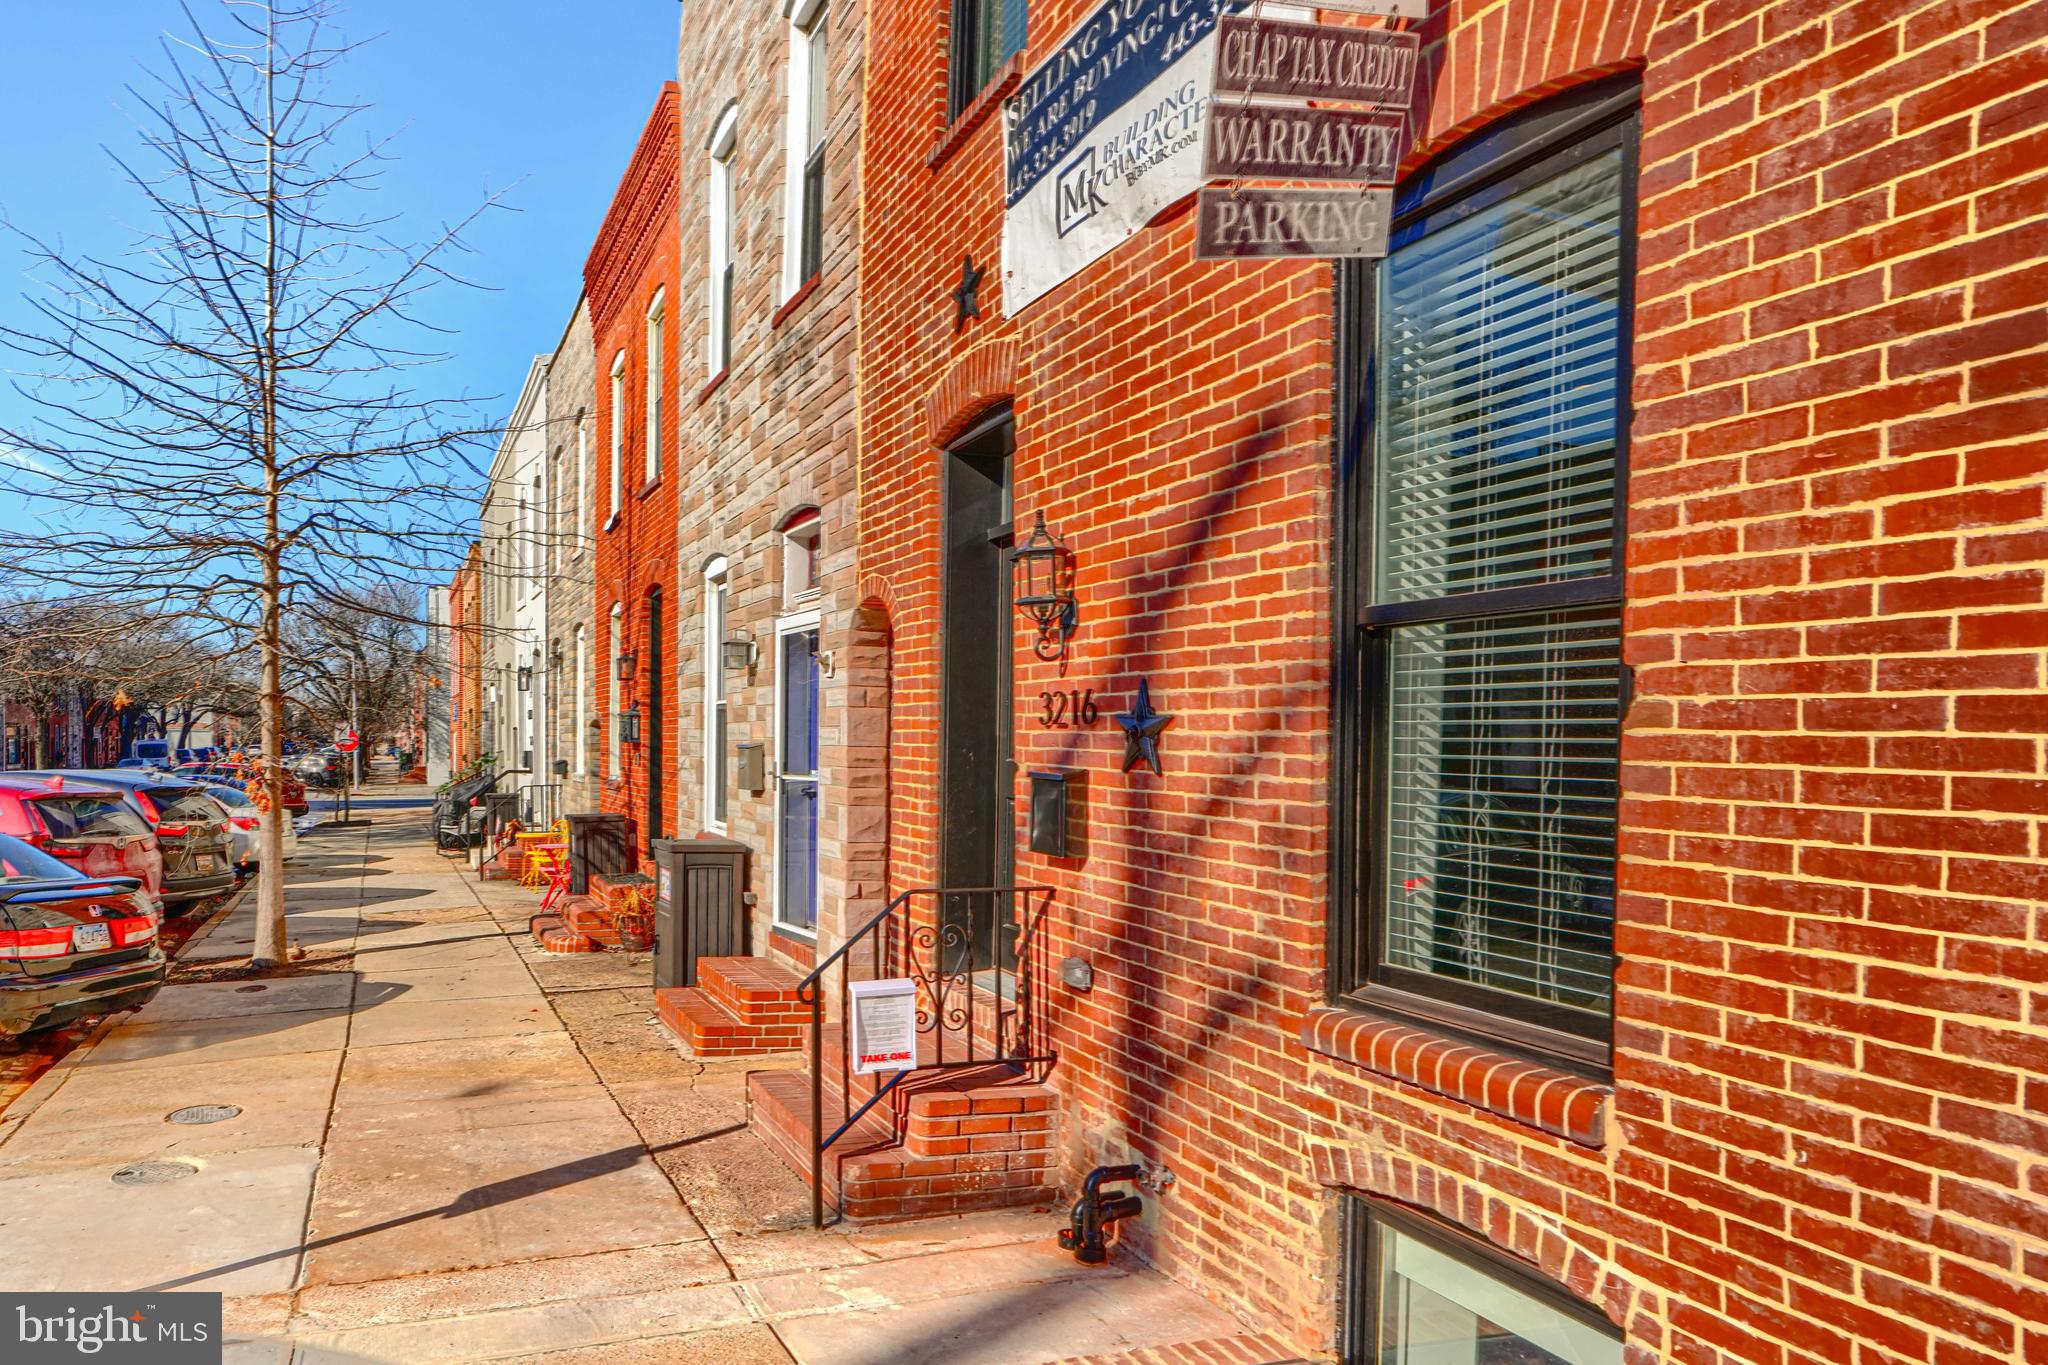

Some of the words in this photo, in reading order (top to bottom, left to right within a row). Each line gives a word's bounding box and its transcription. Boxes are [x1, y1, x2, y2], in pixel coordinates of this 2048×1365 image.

[1007, 21, 1099, 131] SELLING
[1007, 125, 1033, 165] WE
[1034, 88, 1070, 142] ARE
[1073, 2, 1165, 105] BUYING!
[1222, 28, 1288, 81] CHAP
[1289, 35, 1336, 85] TAX
[1336, 40, 1414, 91] CREDIT
[1103, 80, 1195, 164] BUILDING
[1213, 116, 1400, 168] WARRANTY
[1063, 168, 1109, 221] MK
[1215, 200, 1379, 244] PARKING
[1039, 688, 1097, 729] 3216
[860, 1053, 888, 1064] TAKE
[889, 1051, 912, 1061] ONE
